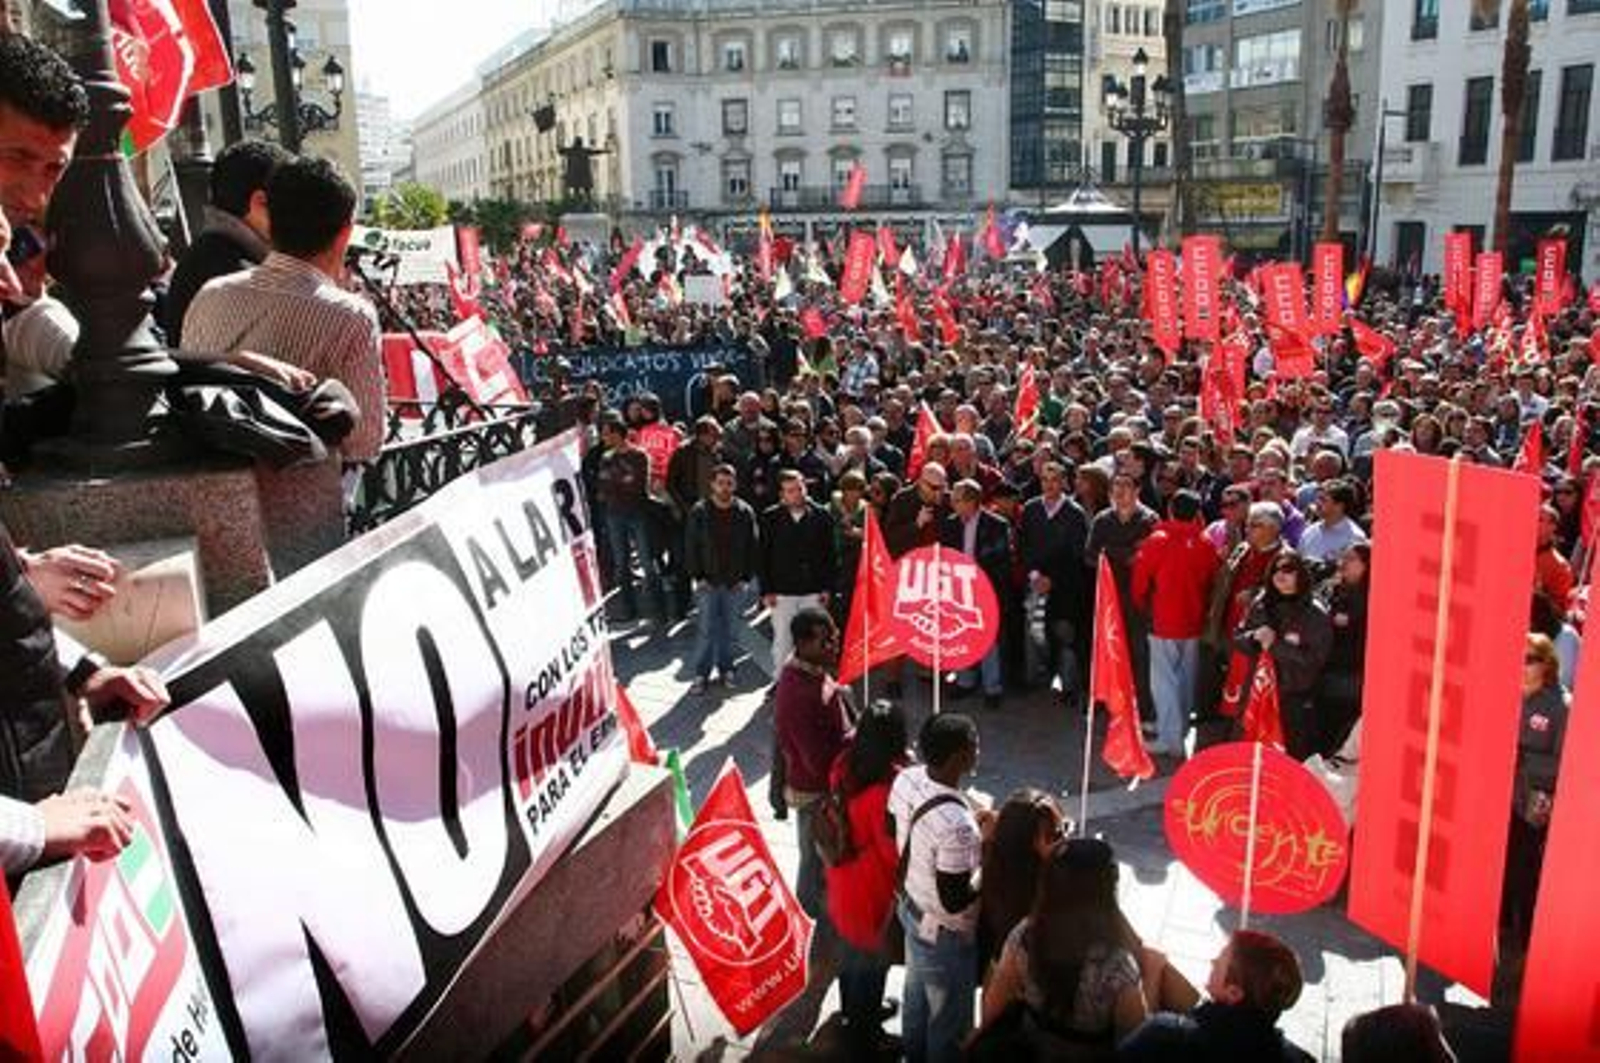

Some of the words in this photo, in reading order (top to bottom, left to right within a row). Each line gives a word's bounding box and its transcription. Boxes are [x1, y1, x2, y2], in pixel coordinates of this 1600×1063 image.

[466, 537, 511, 610] A
[551, 473, 592, 544] R
[898, 558, 978, 610] UGT
[525, 658, 562, 711] CON
[561, 627, 589, 672] LOS
[148, 560, 509, 1063] NO
[526, 767, 571, 836] PARA
[569, 743, 588, 777] EL
[699, 830, 782, 934] UGT
